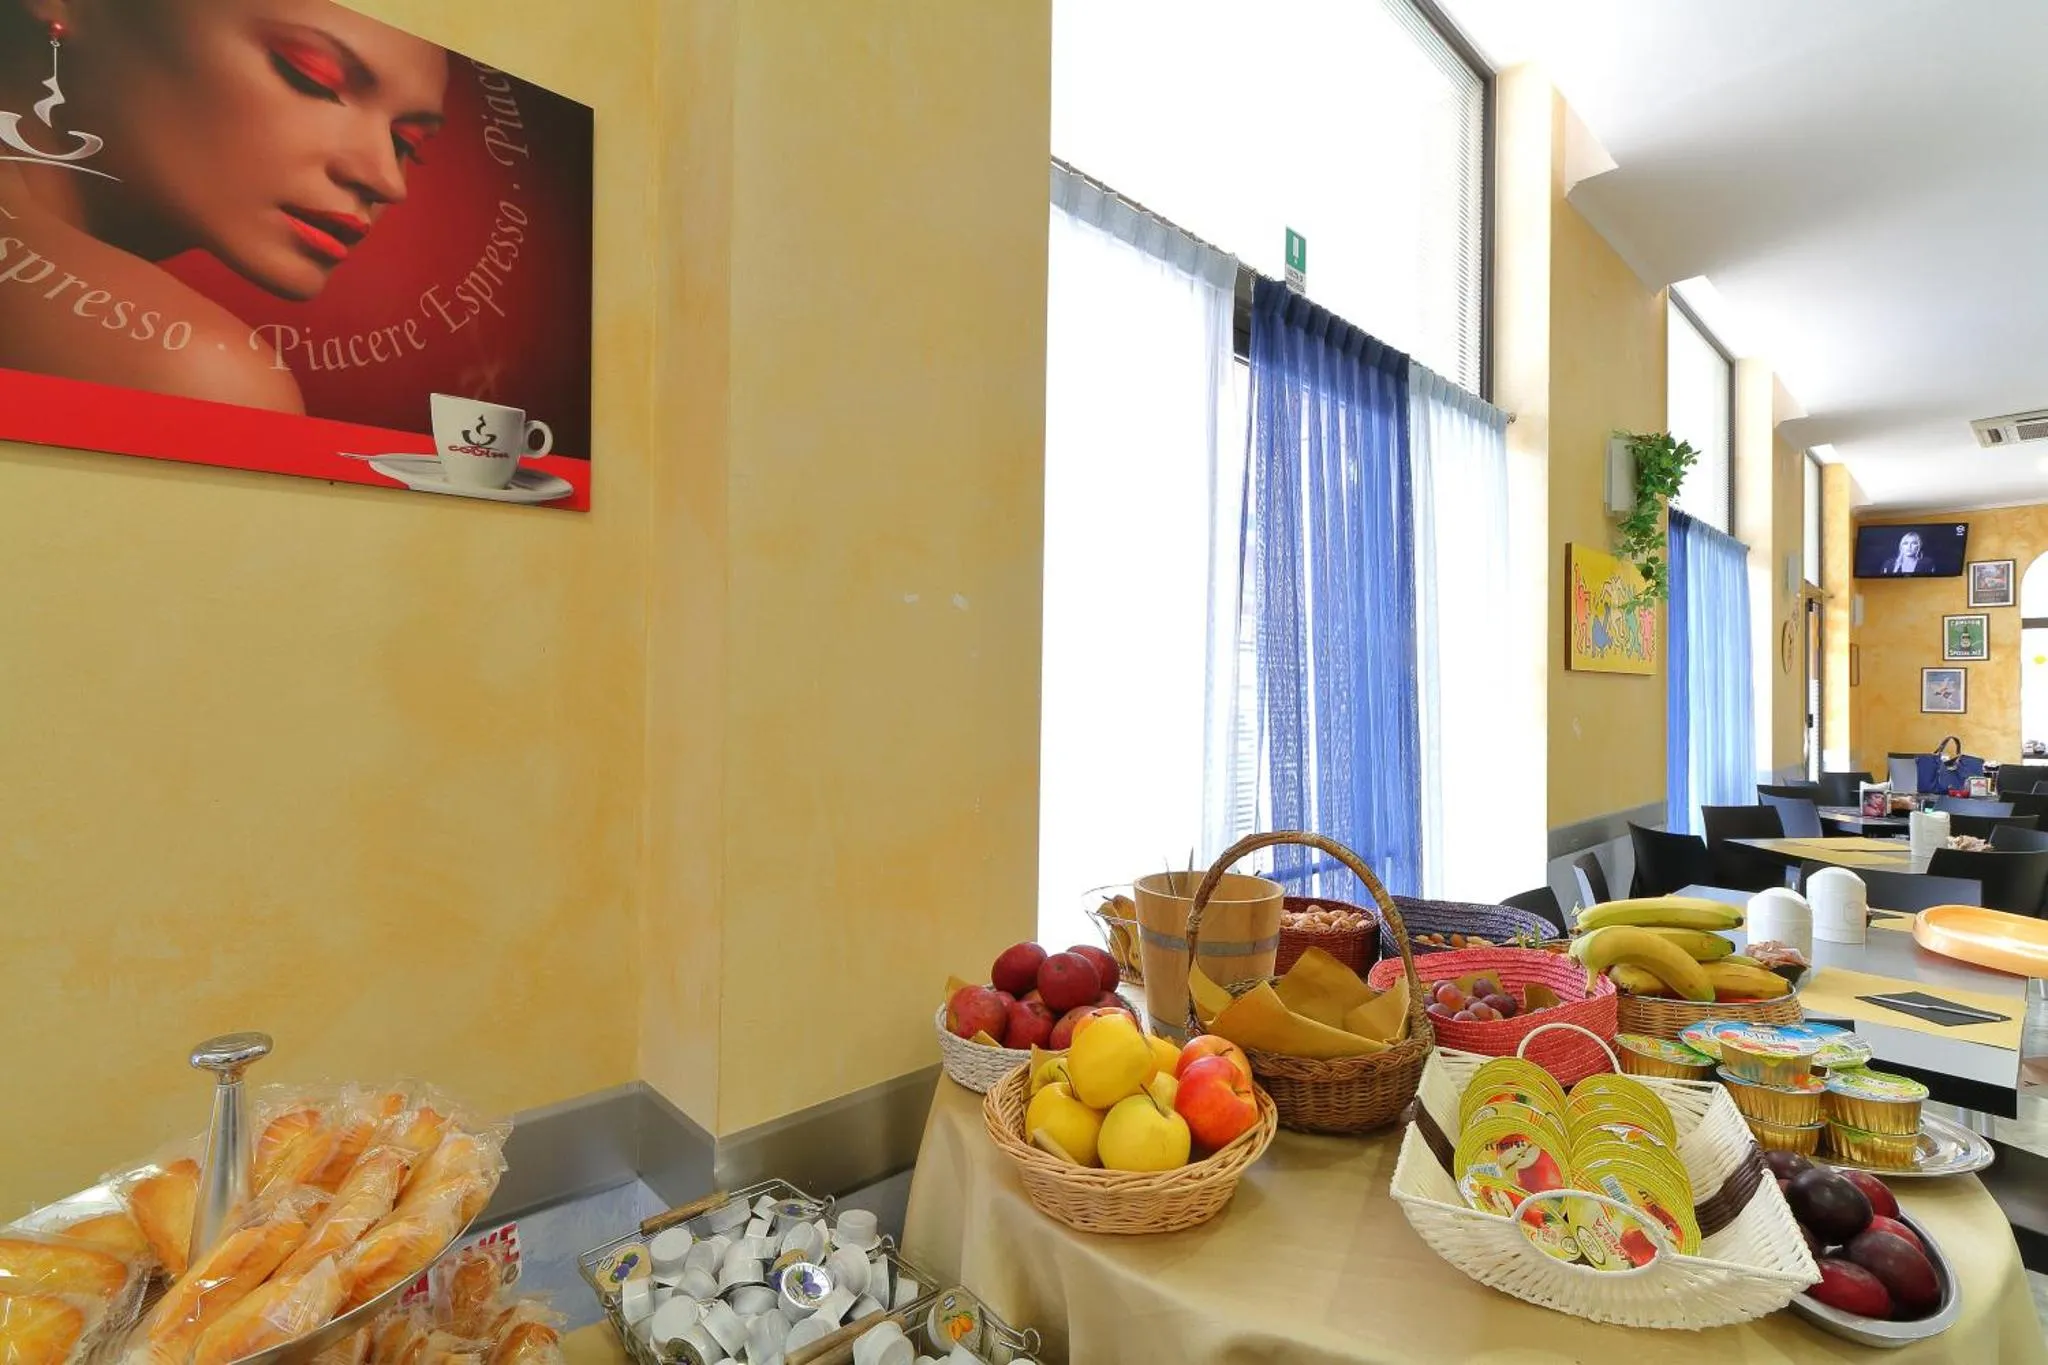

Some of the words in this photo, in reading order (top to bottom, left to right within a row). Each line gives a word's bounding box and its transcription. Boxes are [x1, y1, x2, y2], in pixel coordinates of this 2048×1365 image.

[0, 201, 192, 351] spresso
[249, 323, 428, 372] Piacere
[420, 200, 529, 333] Espresso
